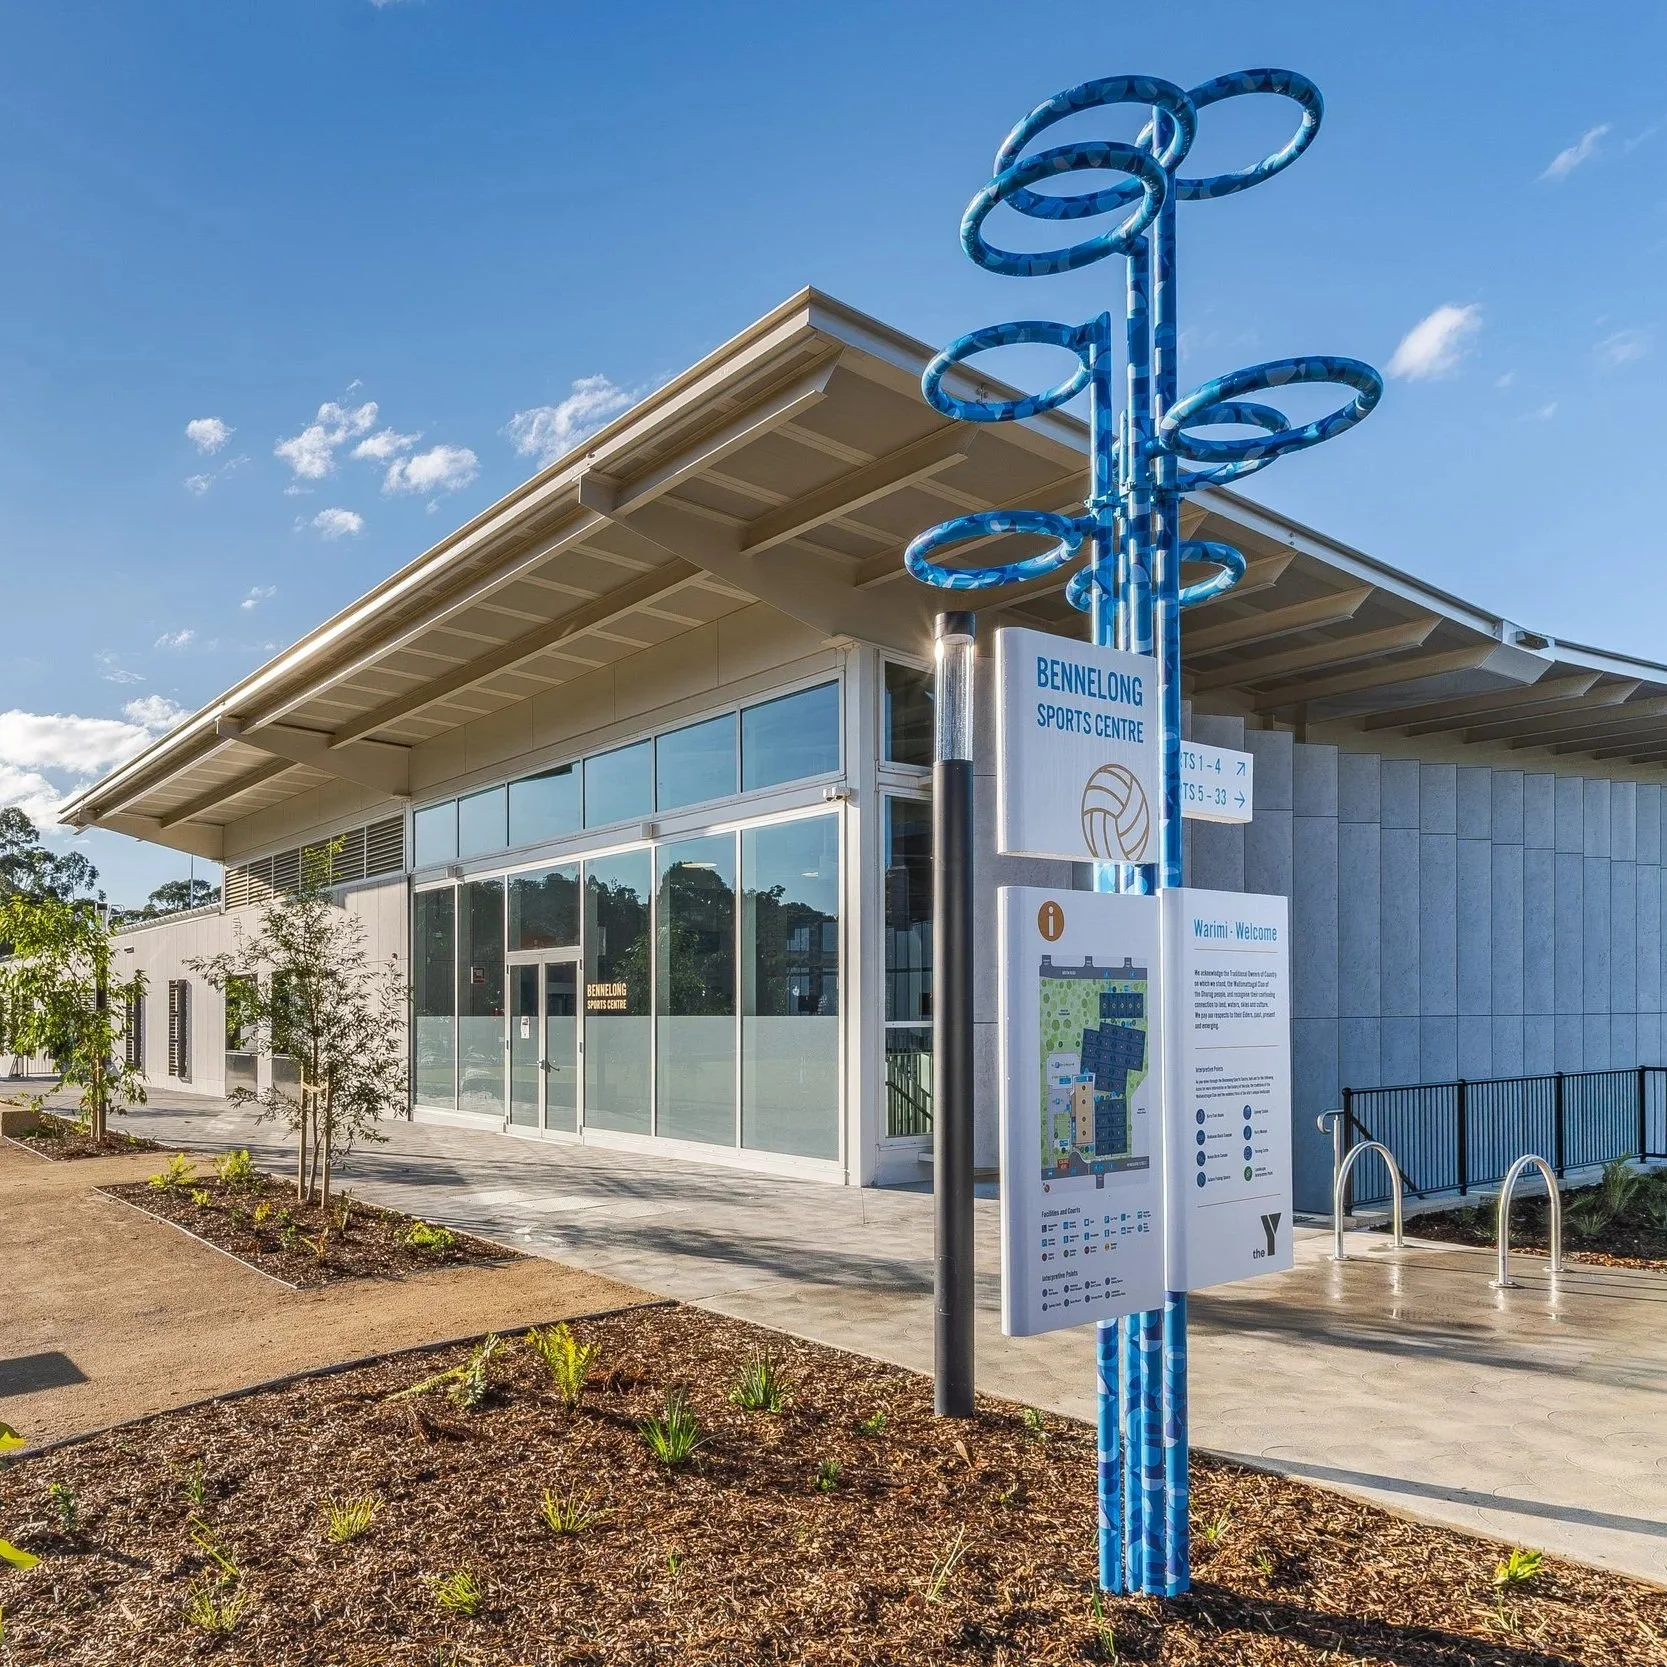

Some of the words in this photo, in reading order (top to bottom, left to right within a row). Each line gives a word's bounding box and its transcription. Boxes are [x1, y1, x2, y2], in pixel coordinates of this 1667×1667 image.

[1037, 656, 1143, 707] BENNELONG
[1037, 703, 1092, 735] SPORTS
[1095, 713, 1144, 744] CENTRE
[1199, 755, 1203, 771] 1
[1215, 758, 1221, 774] 4
[1198, 785, 1204, 802] 5
[1215, 788, 1227, 805] 33
[1194, 919, 1228, 939] Warimi
[1235, 921, 1278, 941] Welcome
[587, 983, 627, 997] BENNELONG
[587, 1000, 606, 1009] SPORTS
[607, 1000, 627, 1009] CENTRE
[1253, 1248, 1265, 1259] the
[1260, 1212, 1281, 1256] Y
